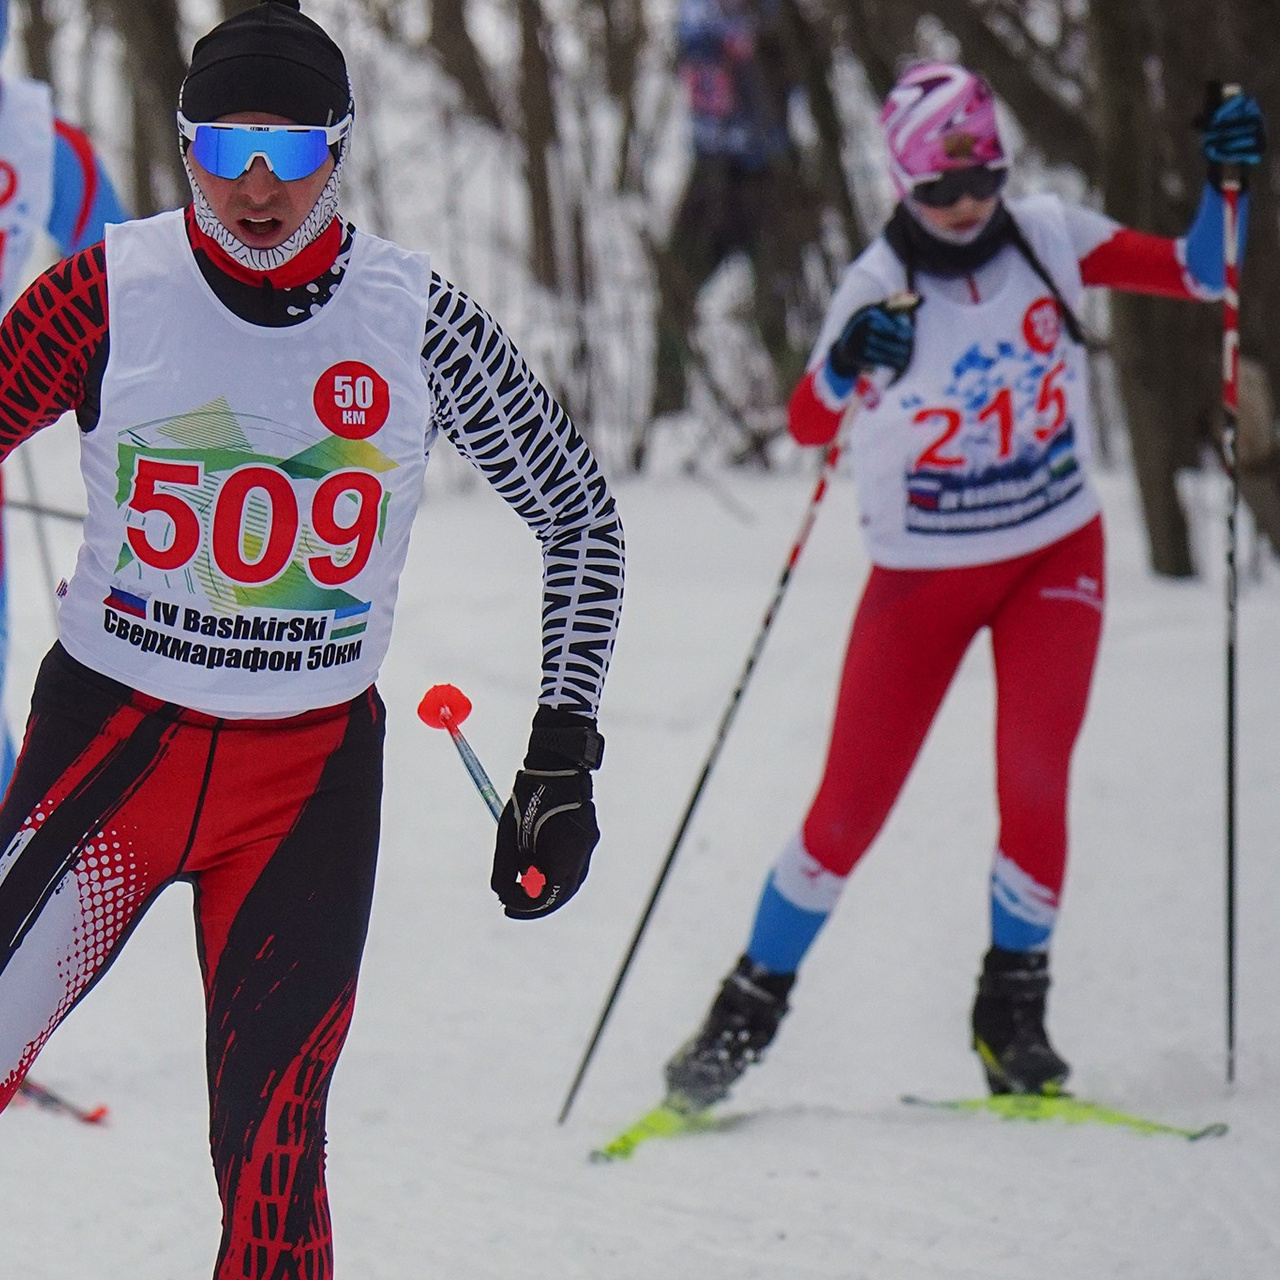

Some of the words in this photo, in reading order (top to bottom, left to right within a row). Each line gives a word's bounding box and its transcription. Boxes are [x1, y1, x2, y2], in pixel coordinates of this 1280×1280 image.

[334, 375, 373, 409] 50
[913, 360, 1066, 470] 215
[126, 458, 383, 586] 509
[103, 608, 302, 673] Сверхмарафон
[153, 599, 179, 628] IV
[183, 608, 328, 642] BashkirSki
